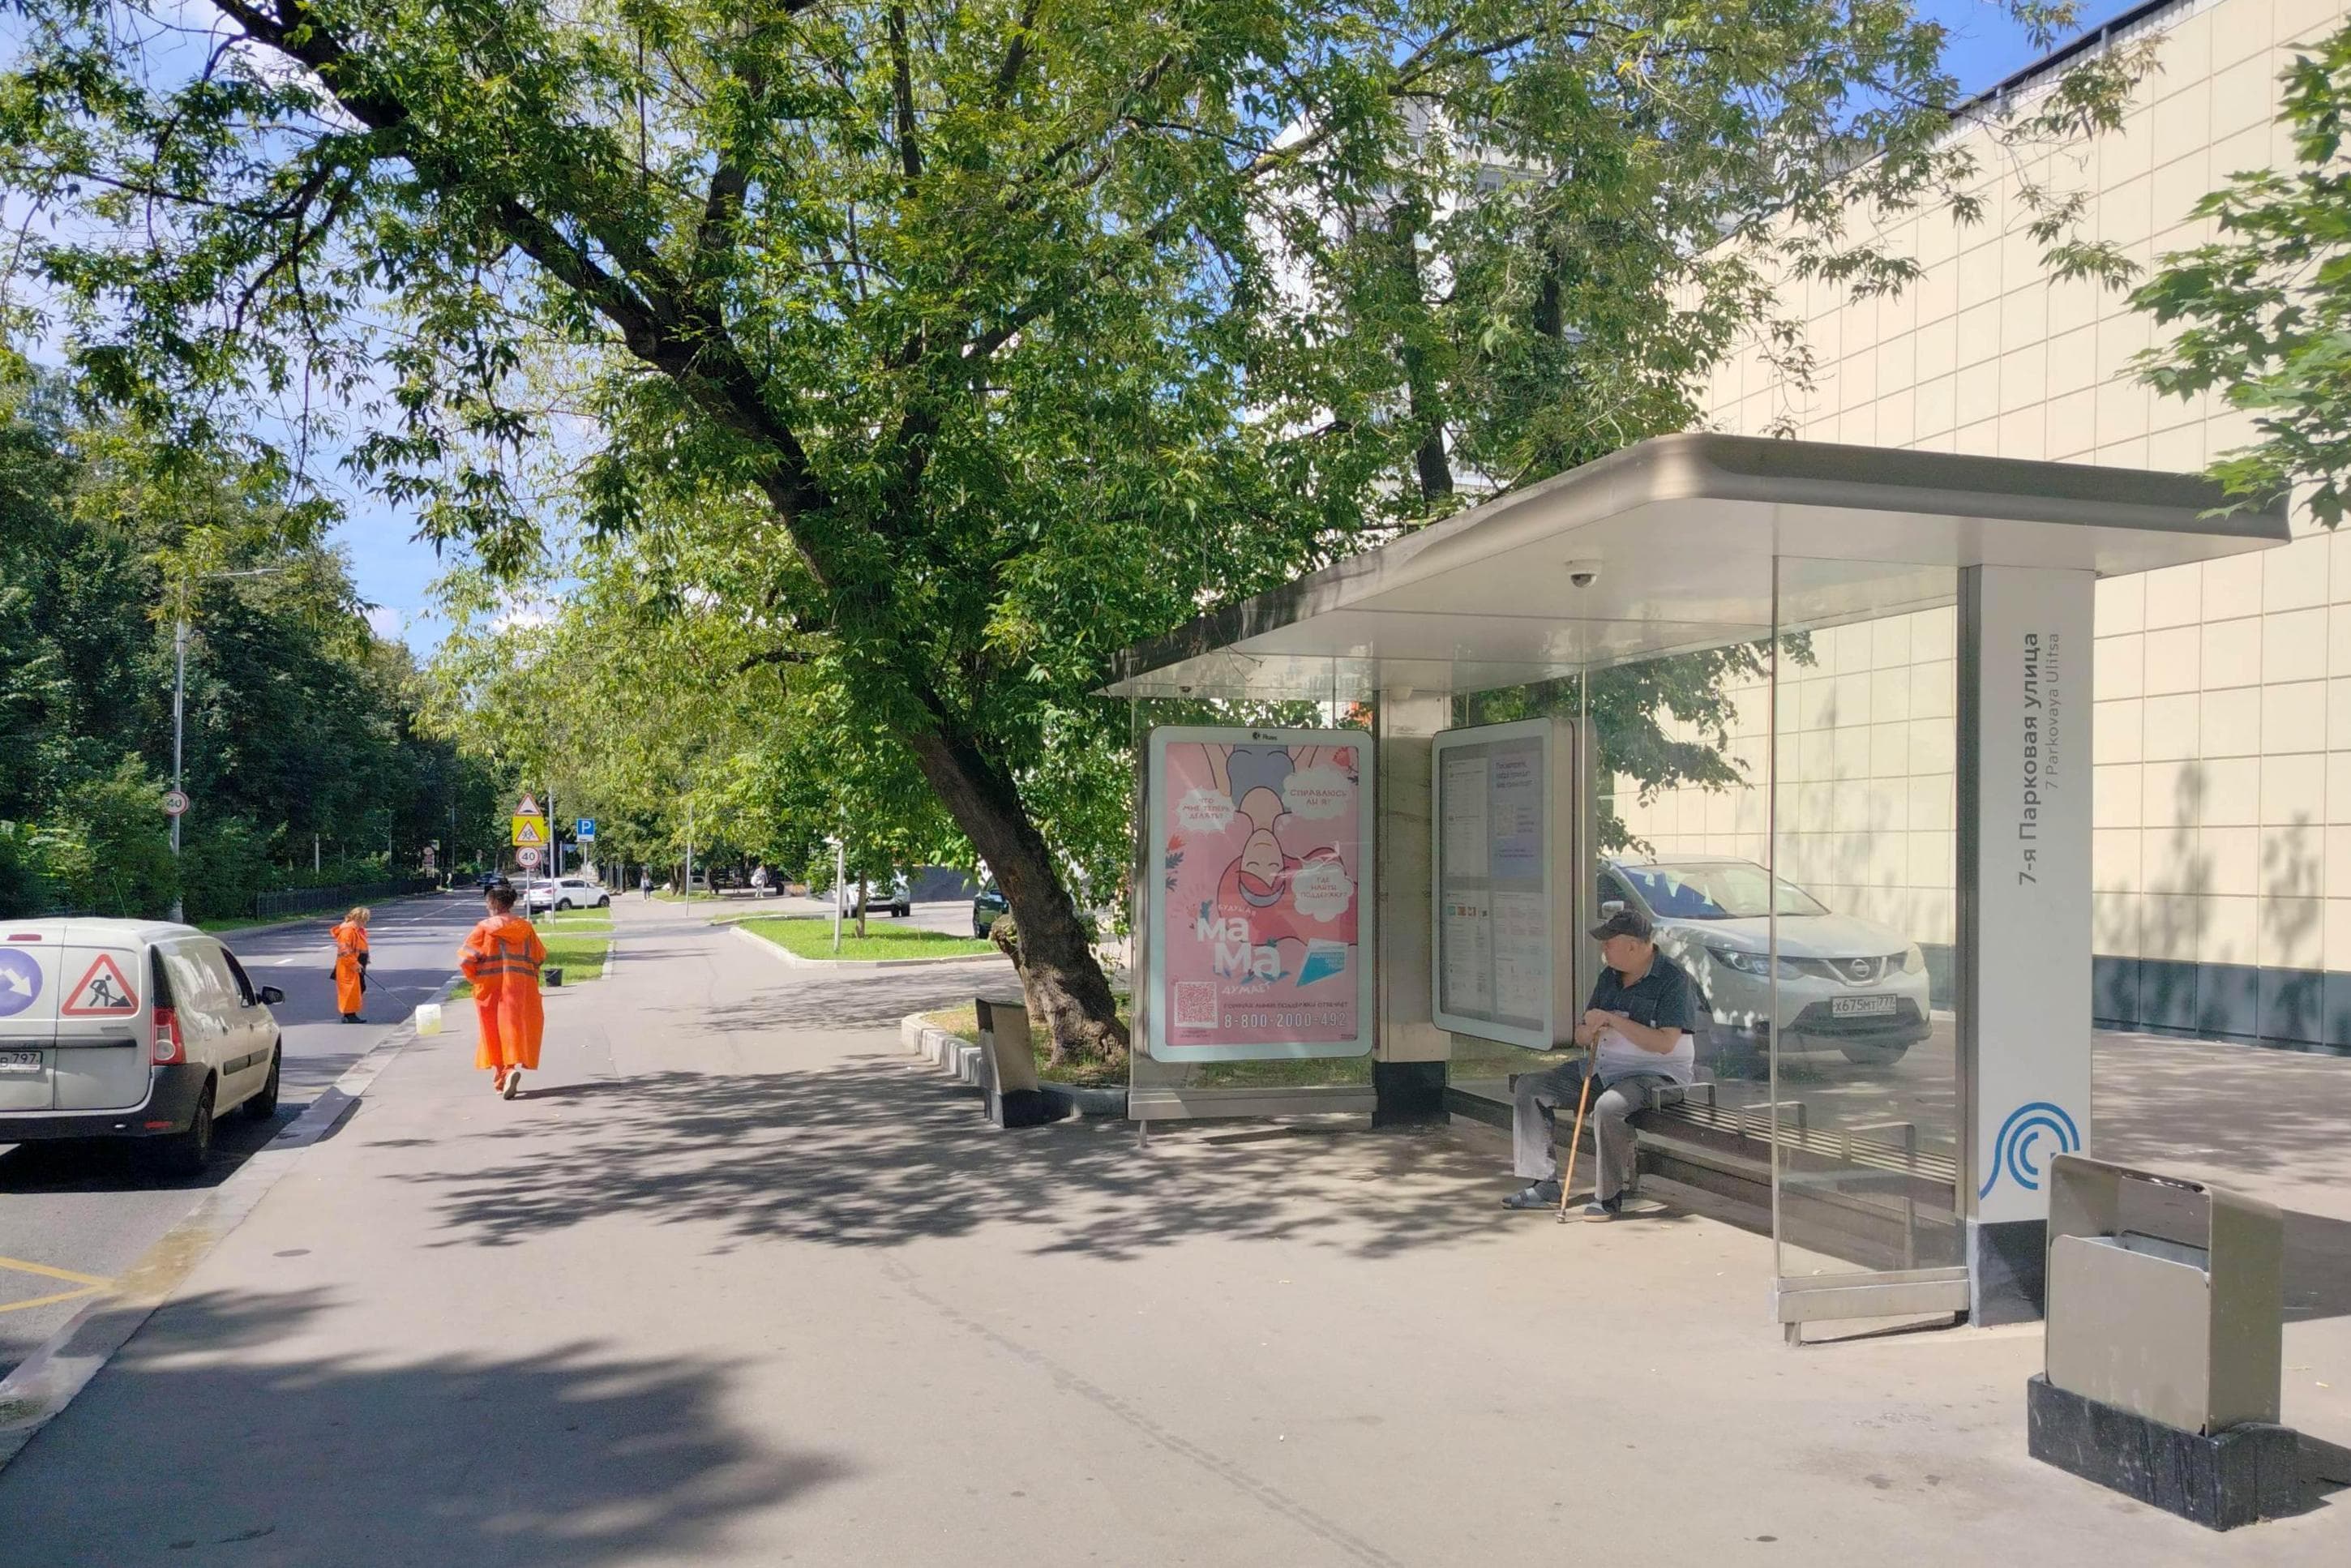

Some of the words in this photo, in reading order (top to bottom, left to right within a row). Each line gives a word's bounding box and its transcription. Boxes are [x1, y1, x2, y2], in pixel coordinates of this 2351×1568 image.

[2045, 633, 2060, 683] Ulitsa
[2023, 632, 2042, 708] улица
[2045, 688, 2062, 776] Parkovaya
[2019, 716, 2041, 840] Парковая
[2046, 779, 2058, 790] 7
[581, 820, 592, 833] P
[522, 851, 535, 861] 40
[2019, 849, 2038, 885] 7-я
[1222, 981, 1271, 994] ДУМАЕТ
[1878, 996, 1894, 1005] 777
[13, 1053, 36, 1064] 797
